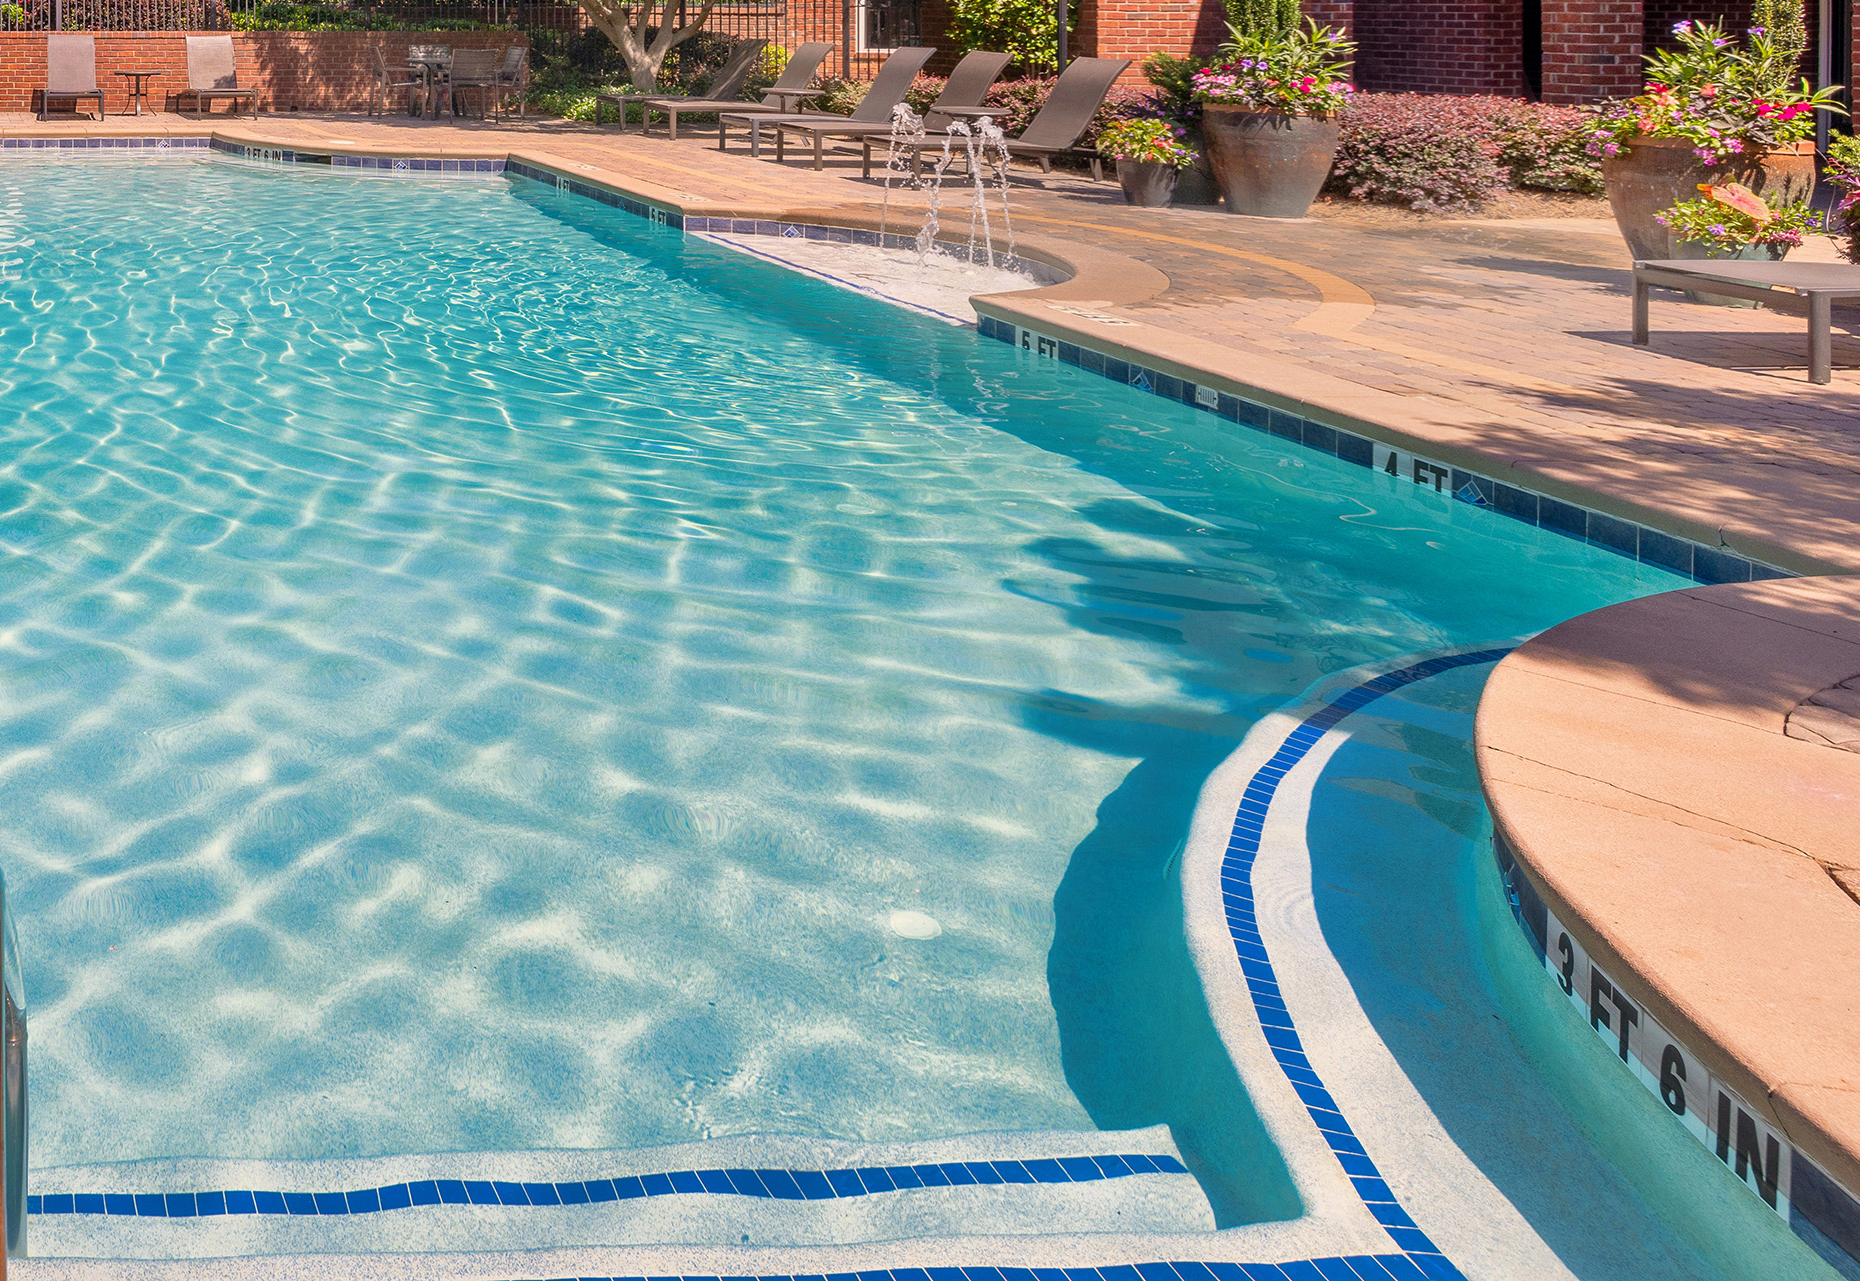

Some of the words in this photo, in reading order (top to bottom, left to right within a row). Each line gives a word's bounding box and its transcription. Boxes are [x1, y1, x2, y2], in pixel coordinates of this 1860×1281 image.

[246, 147, 251, 158] 3
[253, 147, 261, 159] FT
[264, 149, 269, 159] 6
[272, 150, 281, 160] IN
[657, 210, 666, 224] FT
[1022, 330, 1030, 351] 5
[1037, 335, 1057, 359] FT
[1384, 451, 1400, 478] 4
[1413, 458, 1449, 494] FT
[1556, 931, 1575, 998] 3
[1590, 963, 1639, 1066] FT
[1659, 1043, 1688, 1117] 6
[1715, 1089, 1781, 1212] IN
